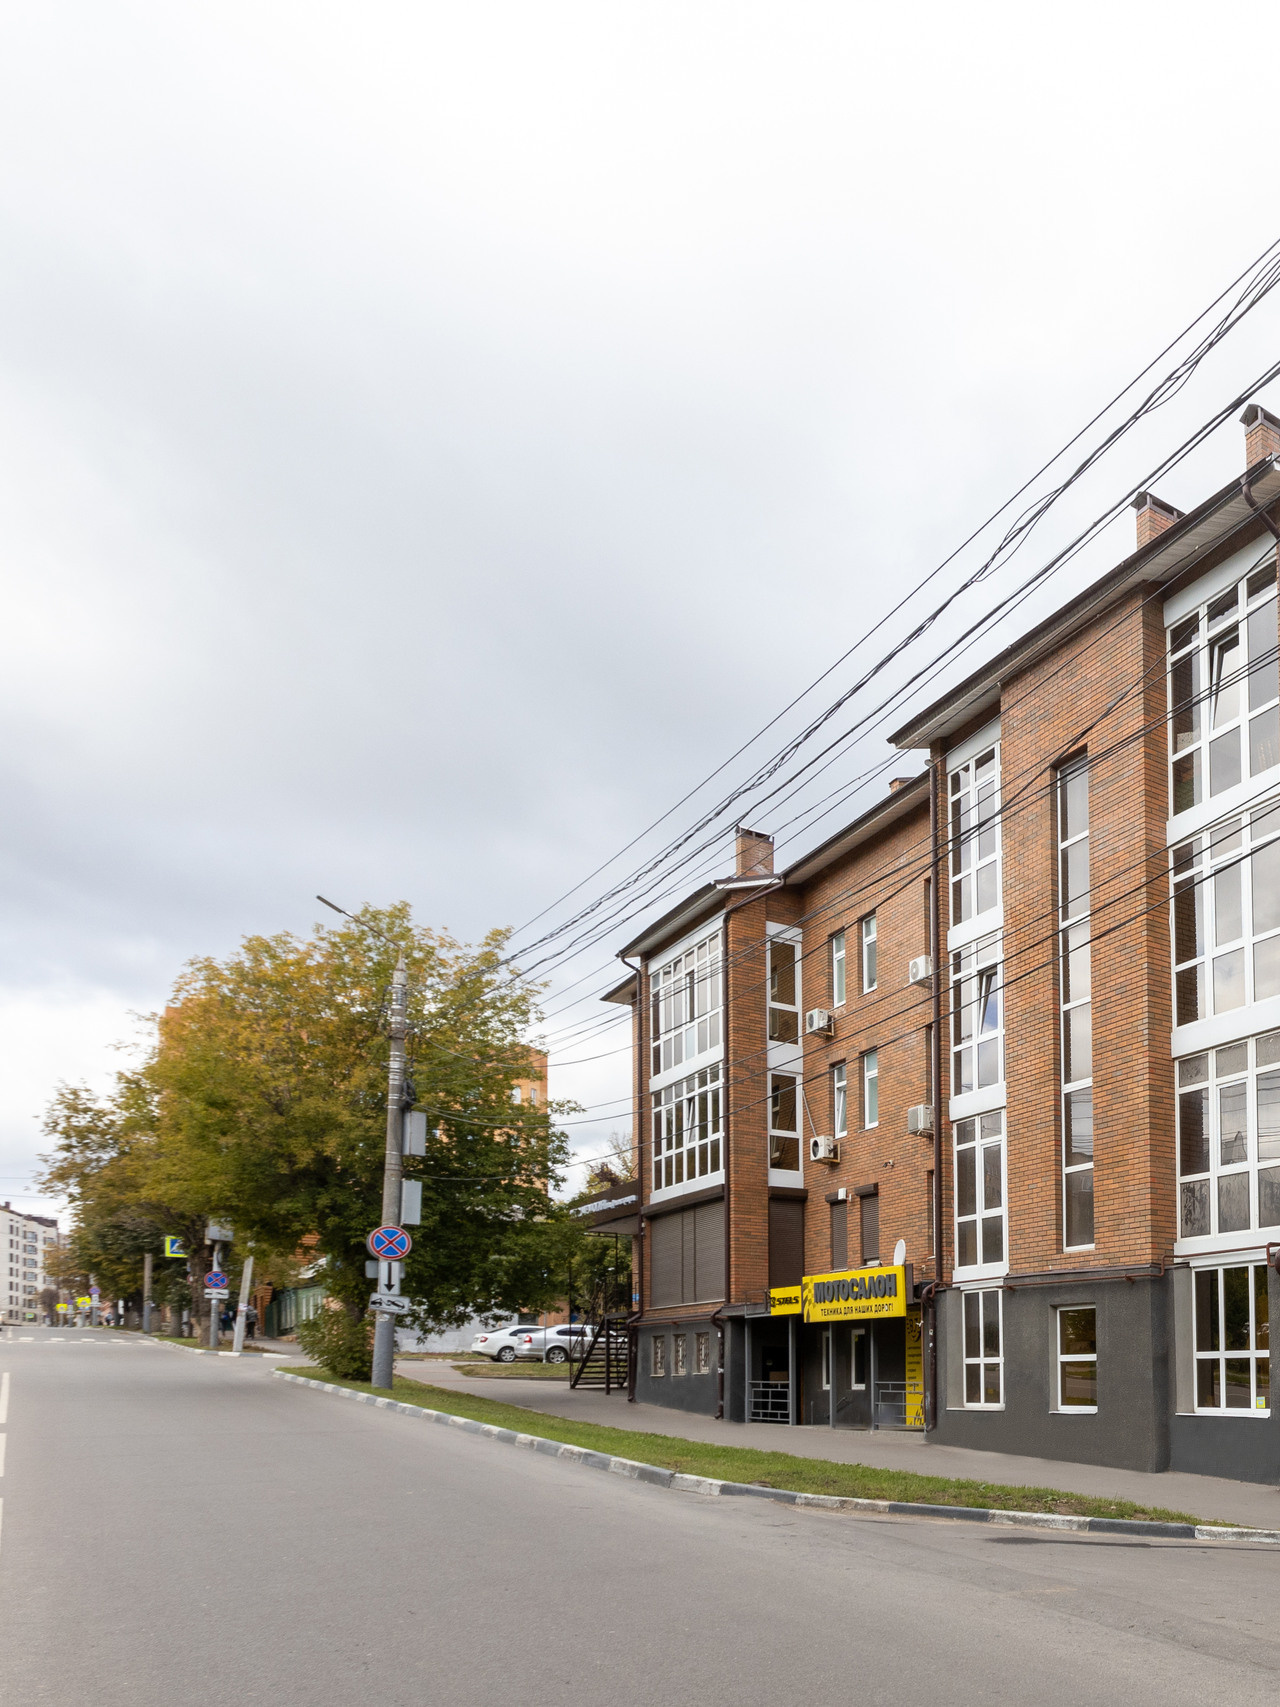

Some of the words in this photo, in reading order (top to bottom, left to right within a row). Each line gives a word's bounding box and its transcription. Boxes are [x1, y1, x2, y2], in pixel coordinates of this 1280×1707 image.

[814, 1273, 897, 1304] МОТОСАЛОН
[821, 1308, 842, 1316] ТЕХНИКА
[844, 1306, 853, 1316] ДЛЯ
[855, 1304, 873, 1314] НАШИХ
[874, 1303, 893, 1313] ДОРОГ!
